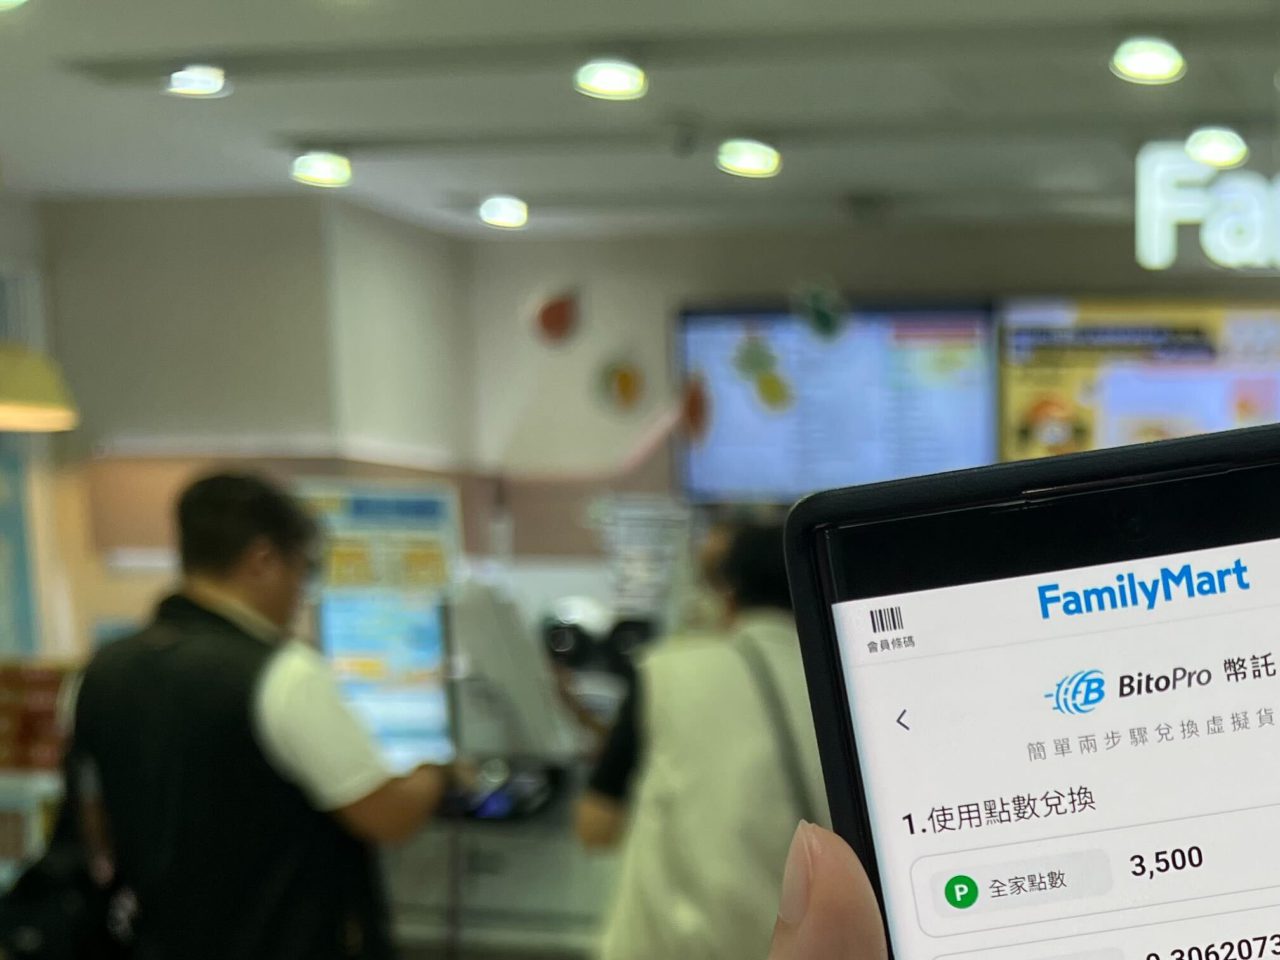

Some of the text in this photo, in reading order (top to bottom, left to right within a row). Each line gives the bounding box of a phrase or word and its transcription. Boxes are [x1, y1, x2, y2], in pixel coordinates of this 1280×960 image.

[1037, 558, 1250, 619] FamilyMart
[1118, 652, 1278, 699] BitoPro 幣託
[1130, 845, 1204, 881] 3,500
[989, 869, 1068, 899] 全家點數
